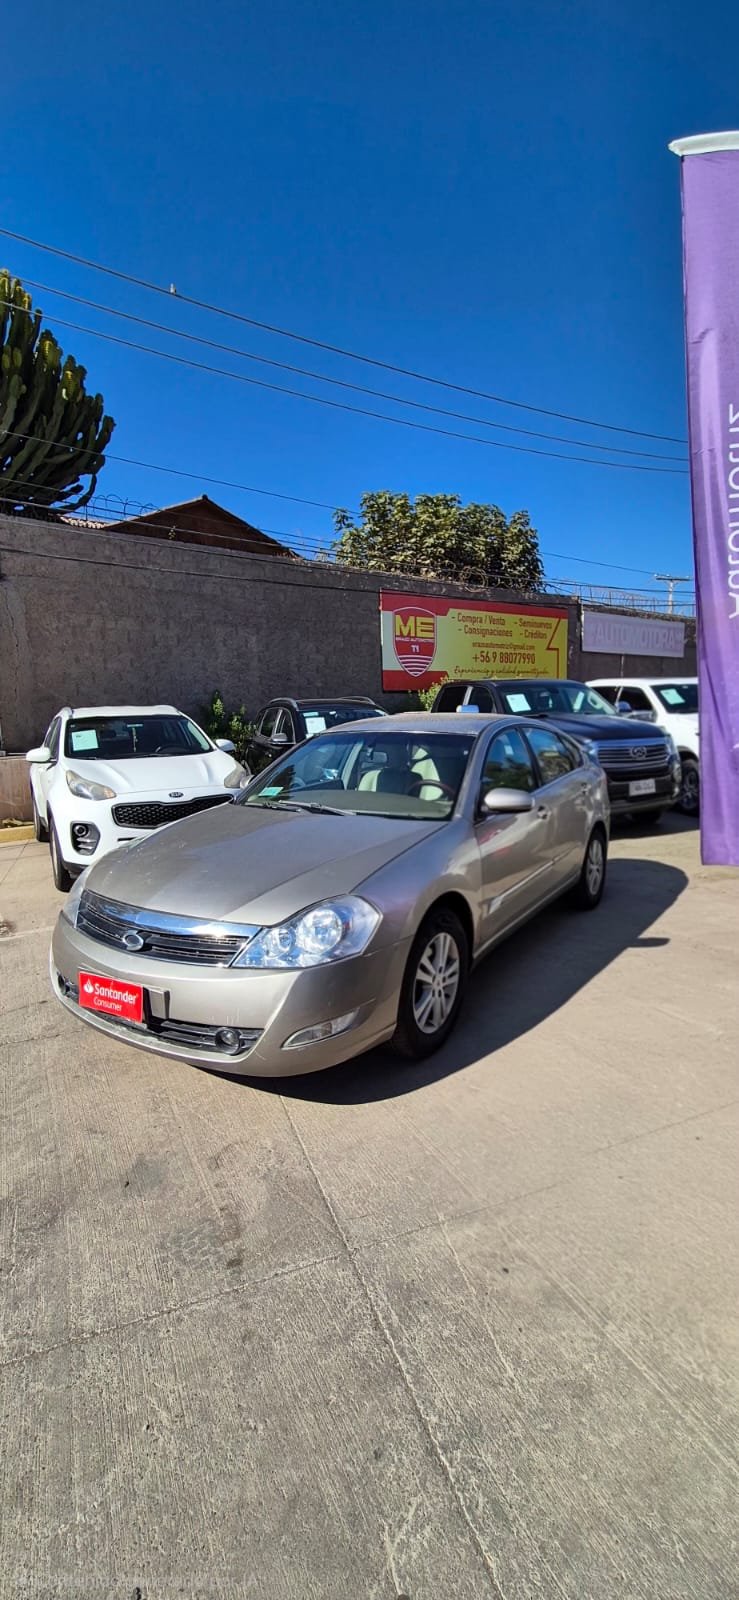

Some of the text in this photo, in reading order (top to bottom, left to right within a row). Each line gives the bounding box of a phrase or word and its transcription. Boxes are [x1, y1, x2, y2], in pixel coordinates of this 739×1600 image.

[395, 614, 434, 638] ME
[457, 613, 483, 626] Compra
[489, 615, 506, 625] Venta
[464, 625, 513, 638] Consignaciones
[472, 650, 536, 665] +56 9 88077990
[94, 982, 137, 1004] Santander
[93, 996, 122, 1011] Consumer
